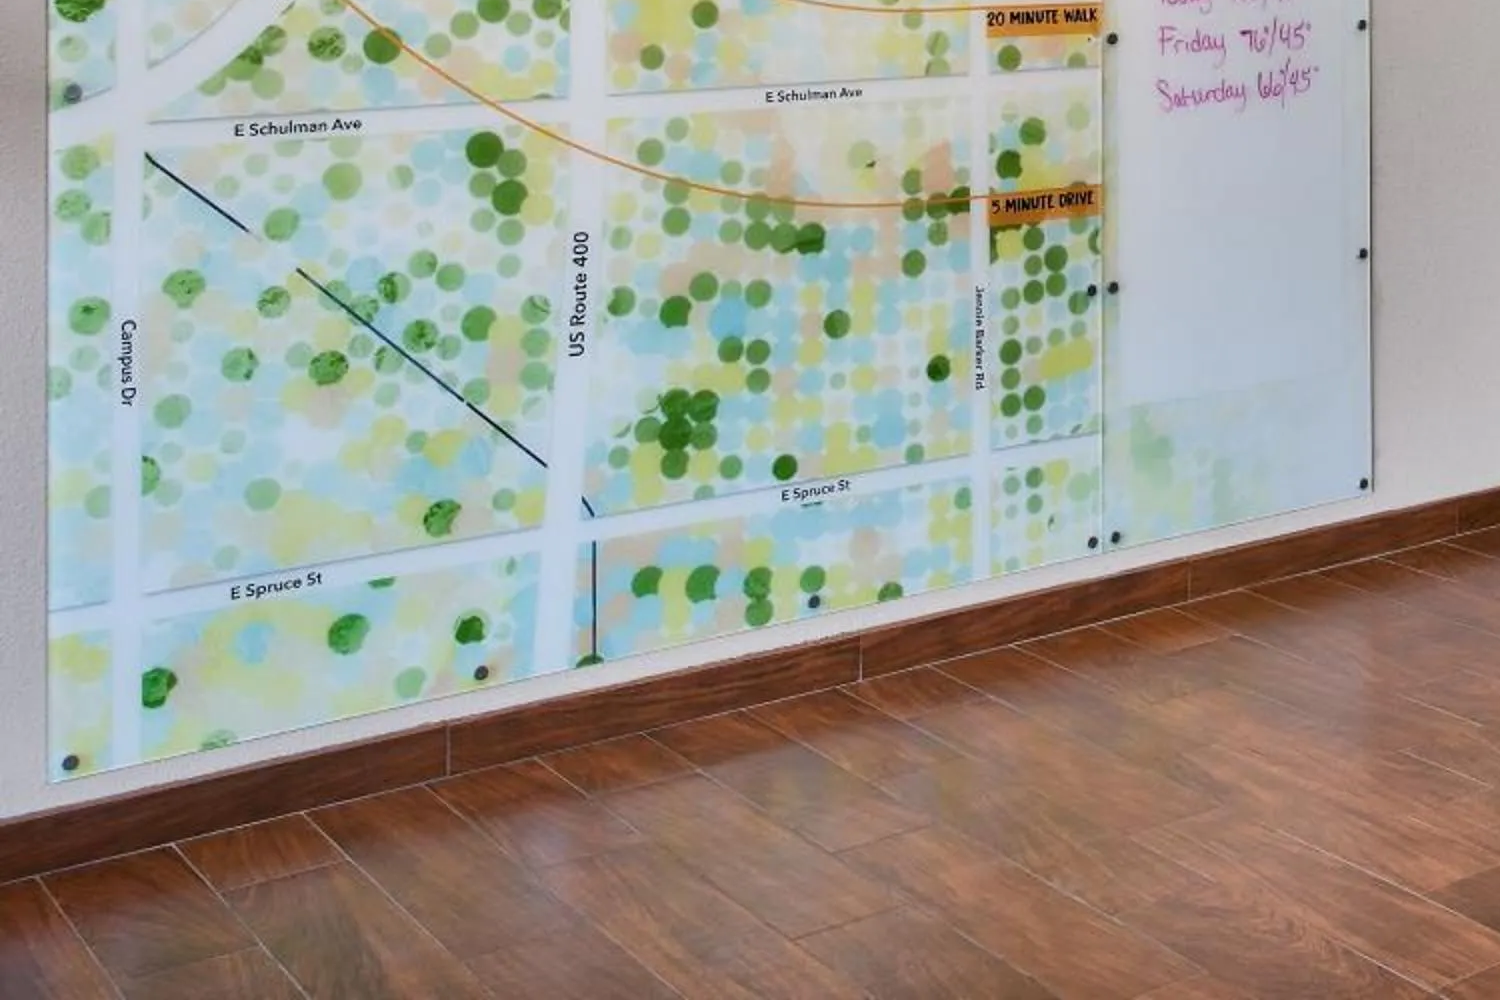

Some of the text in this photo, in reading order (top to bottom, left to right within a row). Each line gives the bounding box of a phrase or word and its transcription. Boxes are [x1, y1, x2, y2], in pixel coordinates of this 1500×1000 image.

[987, 7, 1098, 27] 20 MINUTE WALK
[1159, 25, 1227, 69] Friday
[765, 87, 863, 103] E Schulman Ave
[1157, 78, 1248, 114] Saturday
[234, 118, 362, 137] E Schulman Ave
[991, 190, 1094, 215] 5 MINUTE DRIVE
[568, 231, 589, 358] US Route 400
[117, 319, 137, 407] Campus Dr
[781, 479, 851, 502] E Spruce St
[230, 571, 323, 600] E Spruce St
